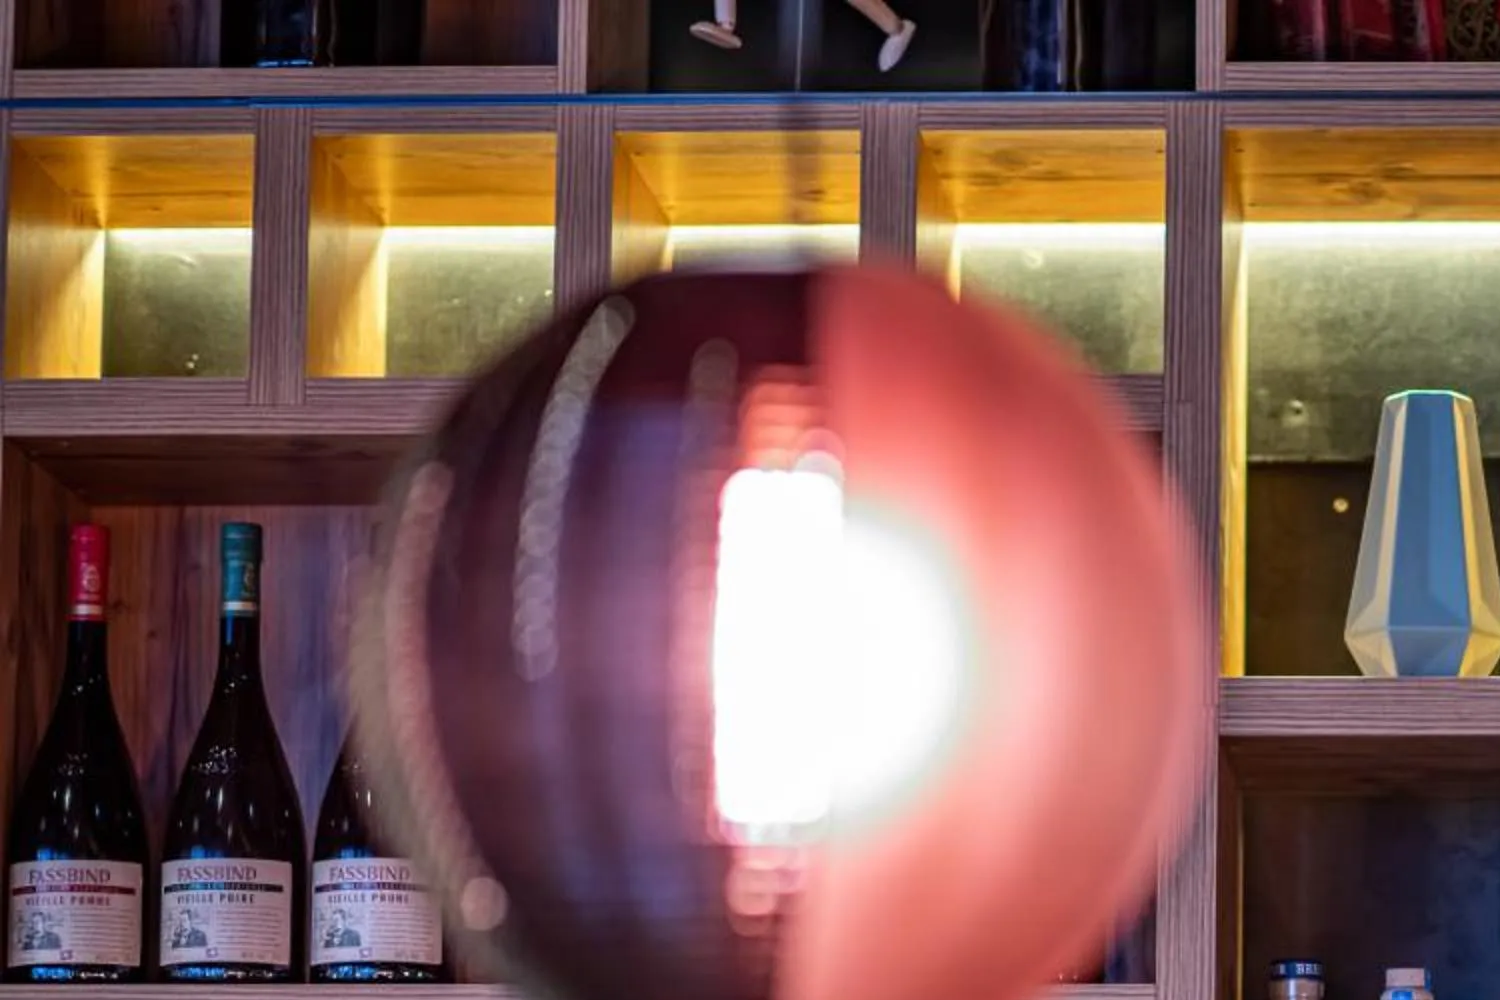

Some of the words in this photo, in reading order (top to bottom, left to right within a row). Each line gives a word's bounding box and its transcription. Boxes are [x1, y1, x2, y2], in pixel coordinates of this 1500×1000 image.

[28, 867, 111, 884] FASSBIND
[177, 865, 257, 881] FASSBIND
[329, 864, 410, 881] FASSBIND
